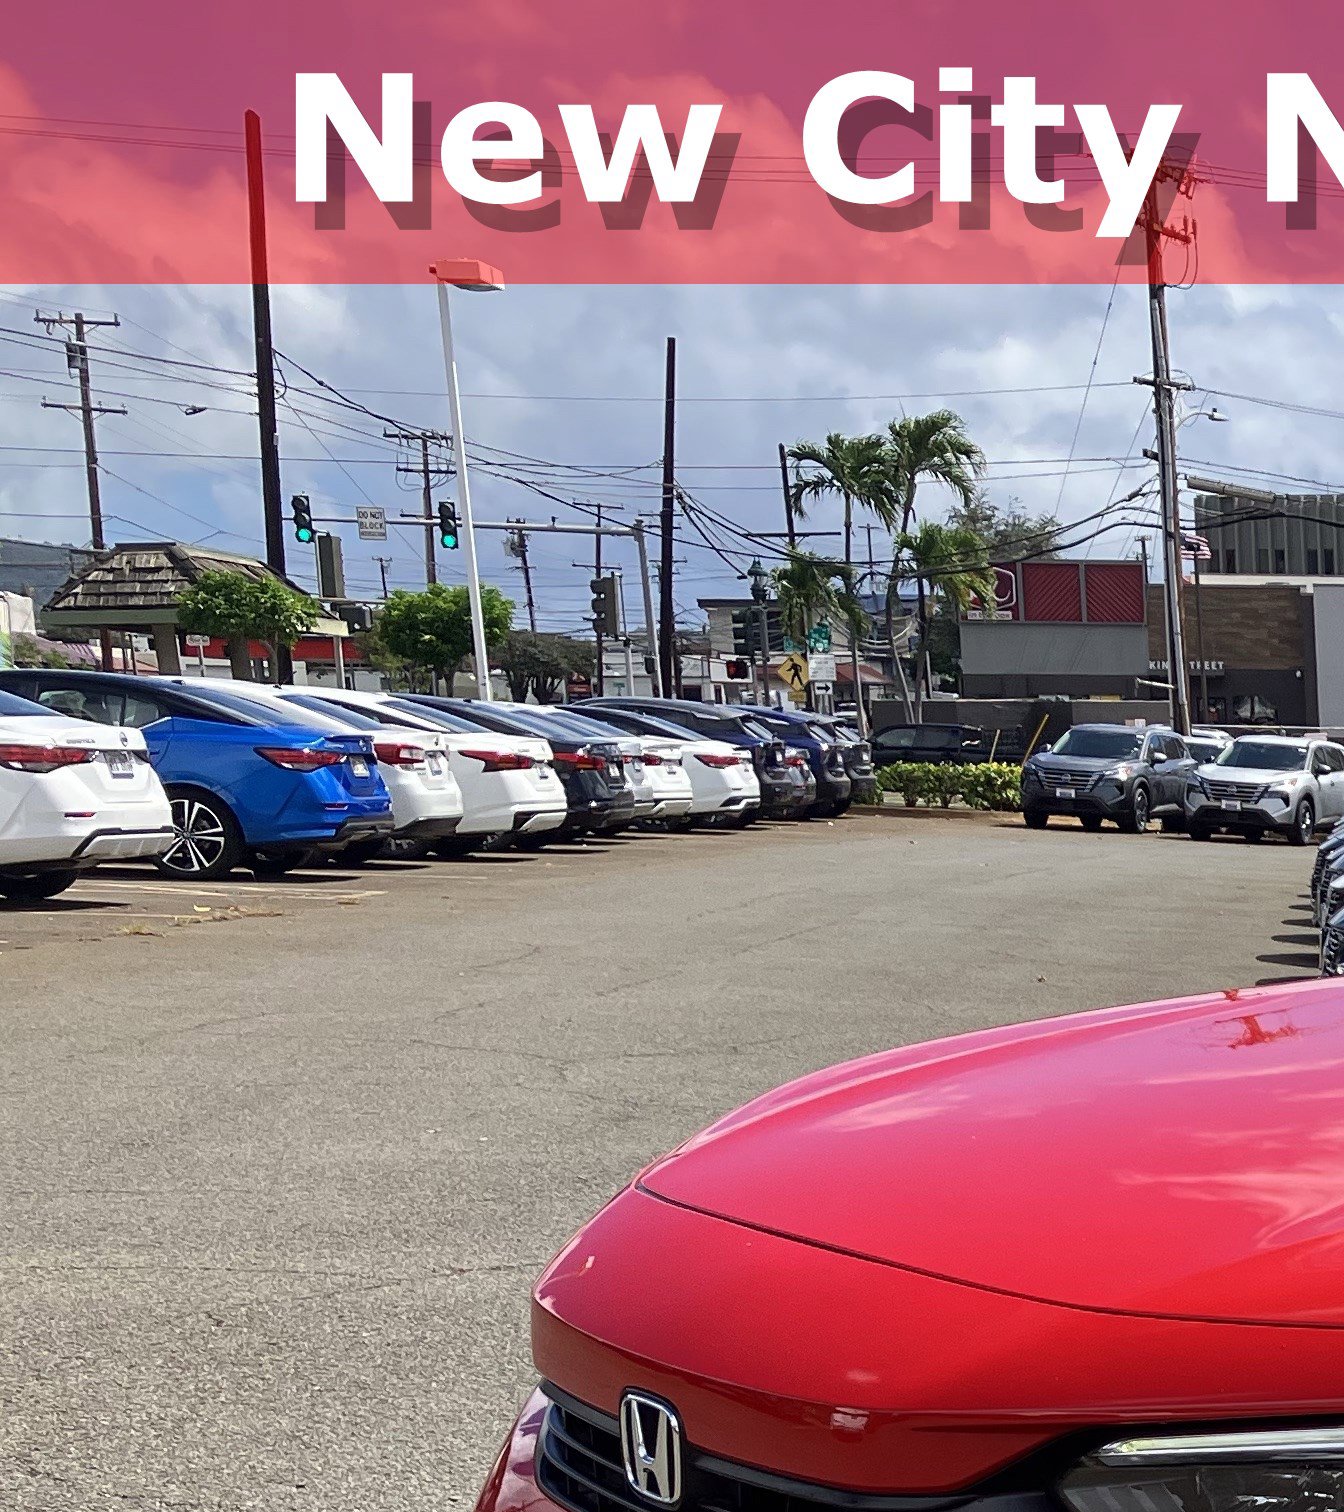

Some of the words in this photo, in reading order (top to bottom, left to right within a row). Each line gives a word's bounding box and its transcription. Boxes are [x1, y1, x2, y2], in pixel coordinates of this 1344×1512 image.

[358, 511, 369, 519] DO
[369, 511, 383, 519] NOT
[1188, 660, 1225, 670] TREET
